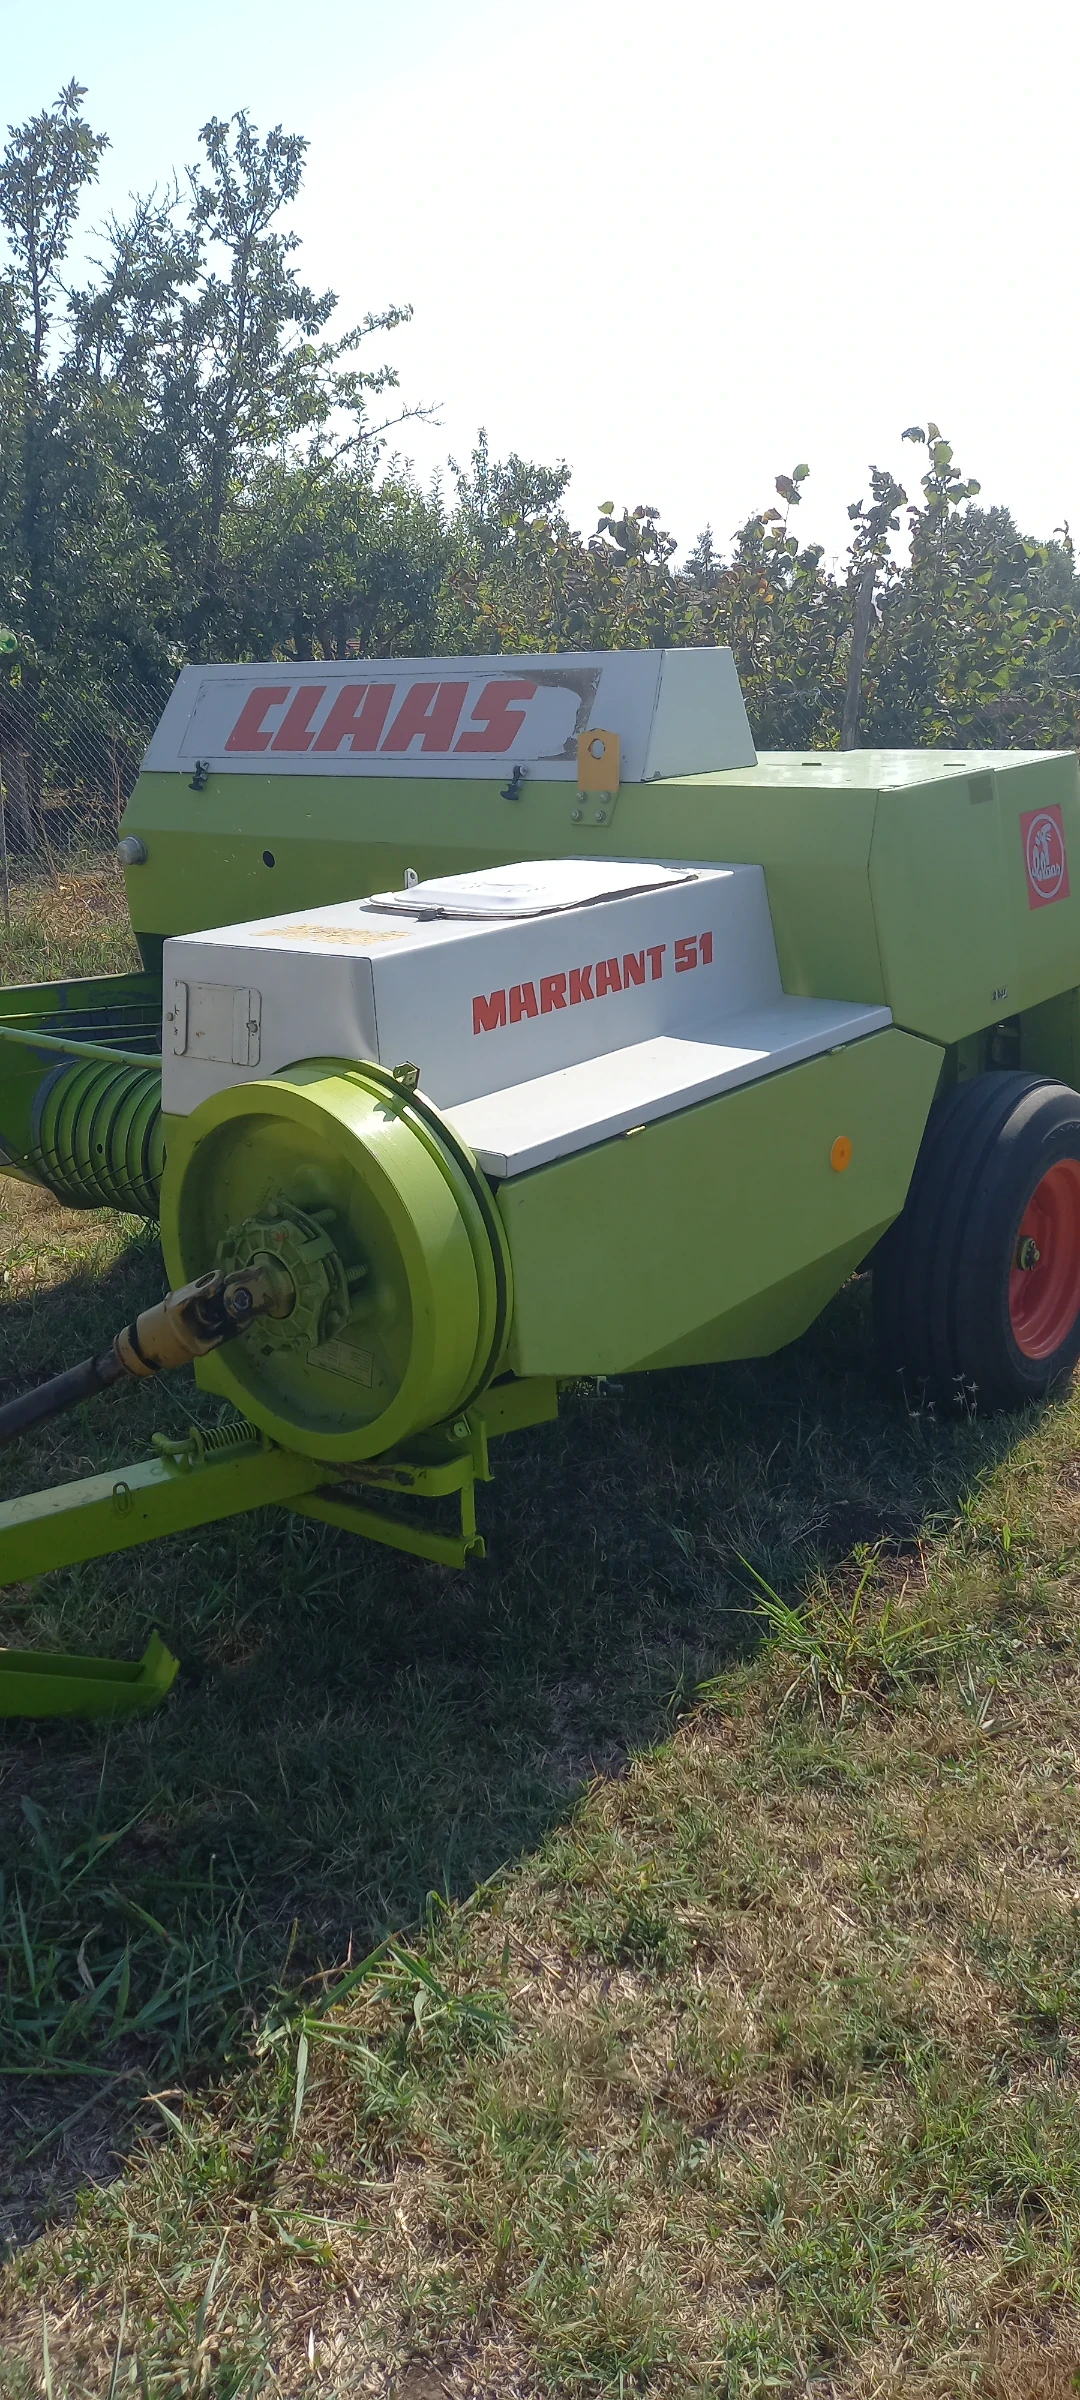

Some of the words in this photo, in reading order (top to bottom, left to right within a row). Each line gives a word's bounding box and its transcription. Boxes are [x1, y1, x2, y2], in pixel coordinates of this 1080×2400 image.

[224, 680, 538, 752] CLAAS
[473, 944, 666, 1035] MARKANT
[674, 931, 713, 973] 51
